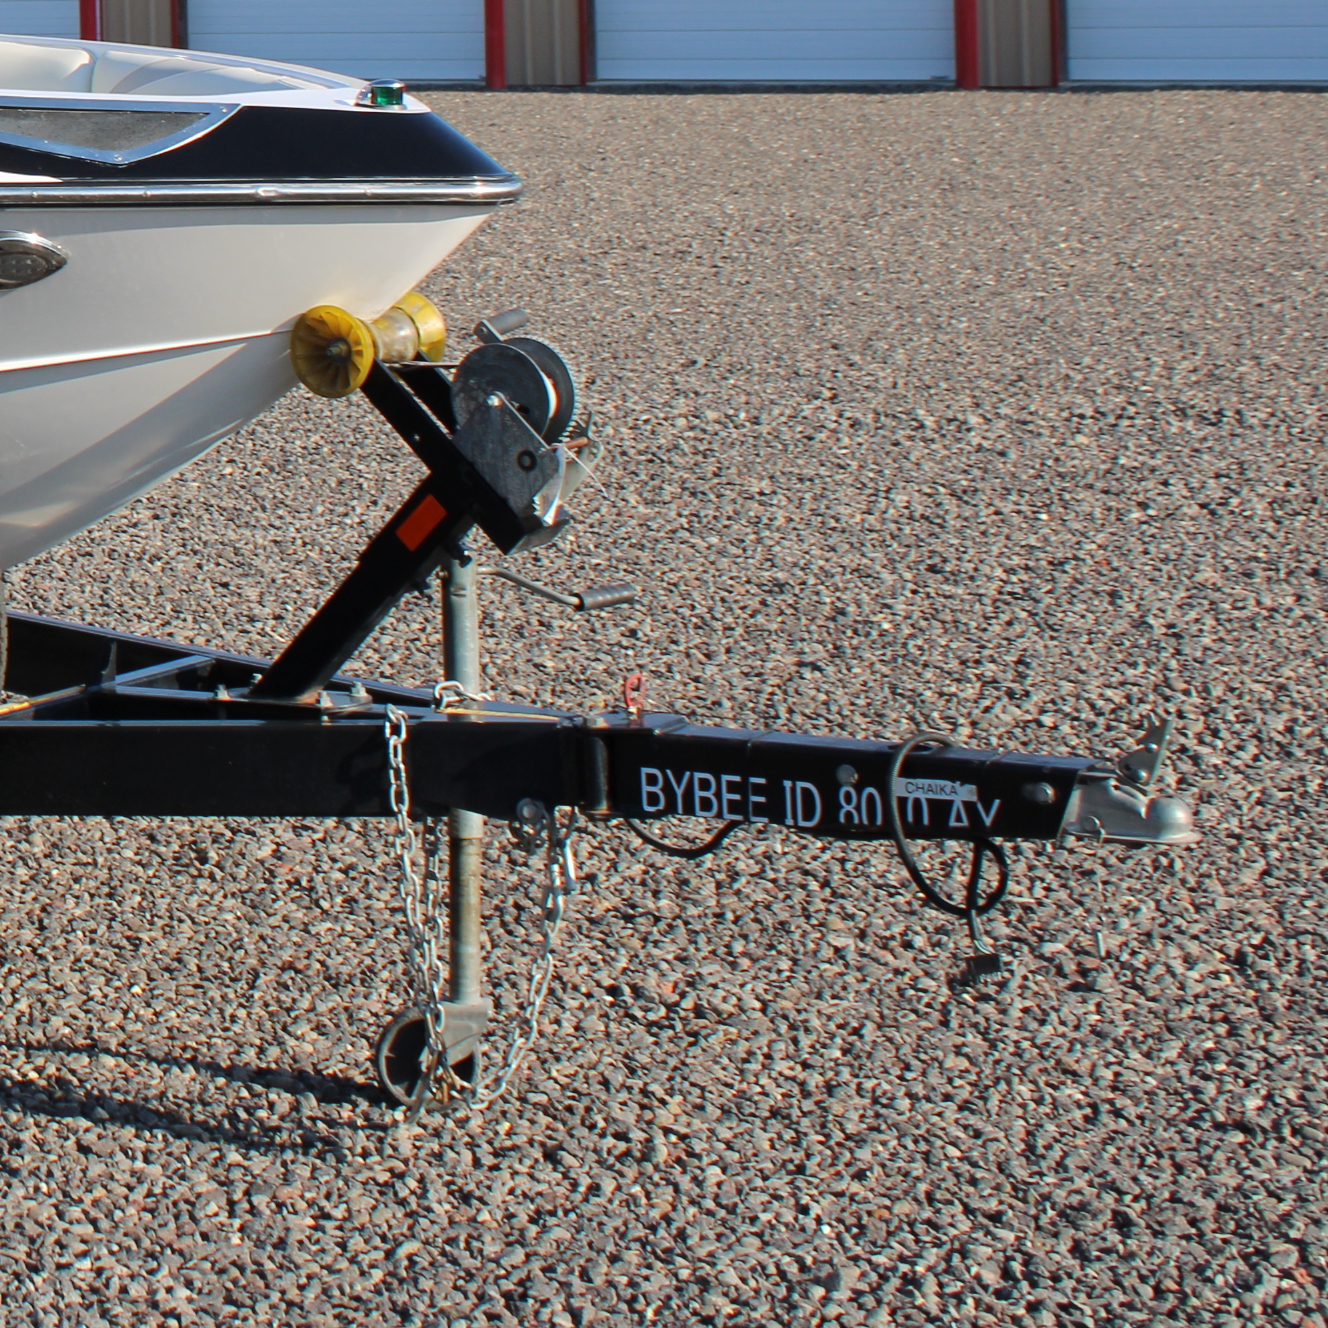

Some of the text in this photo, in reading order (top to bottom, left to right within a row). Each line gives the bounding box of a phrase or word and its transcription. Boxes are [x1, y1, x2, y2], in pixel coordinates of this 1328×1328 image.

[640, 766, 769, 823] BYBEE
[782, 779, 822, 828] ID
[904, 781, 958, 796] CHAIKA
